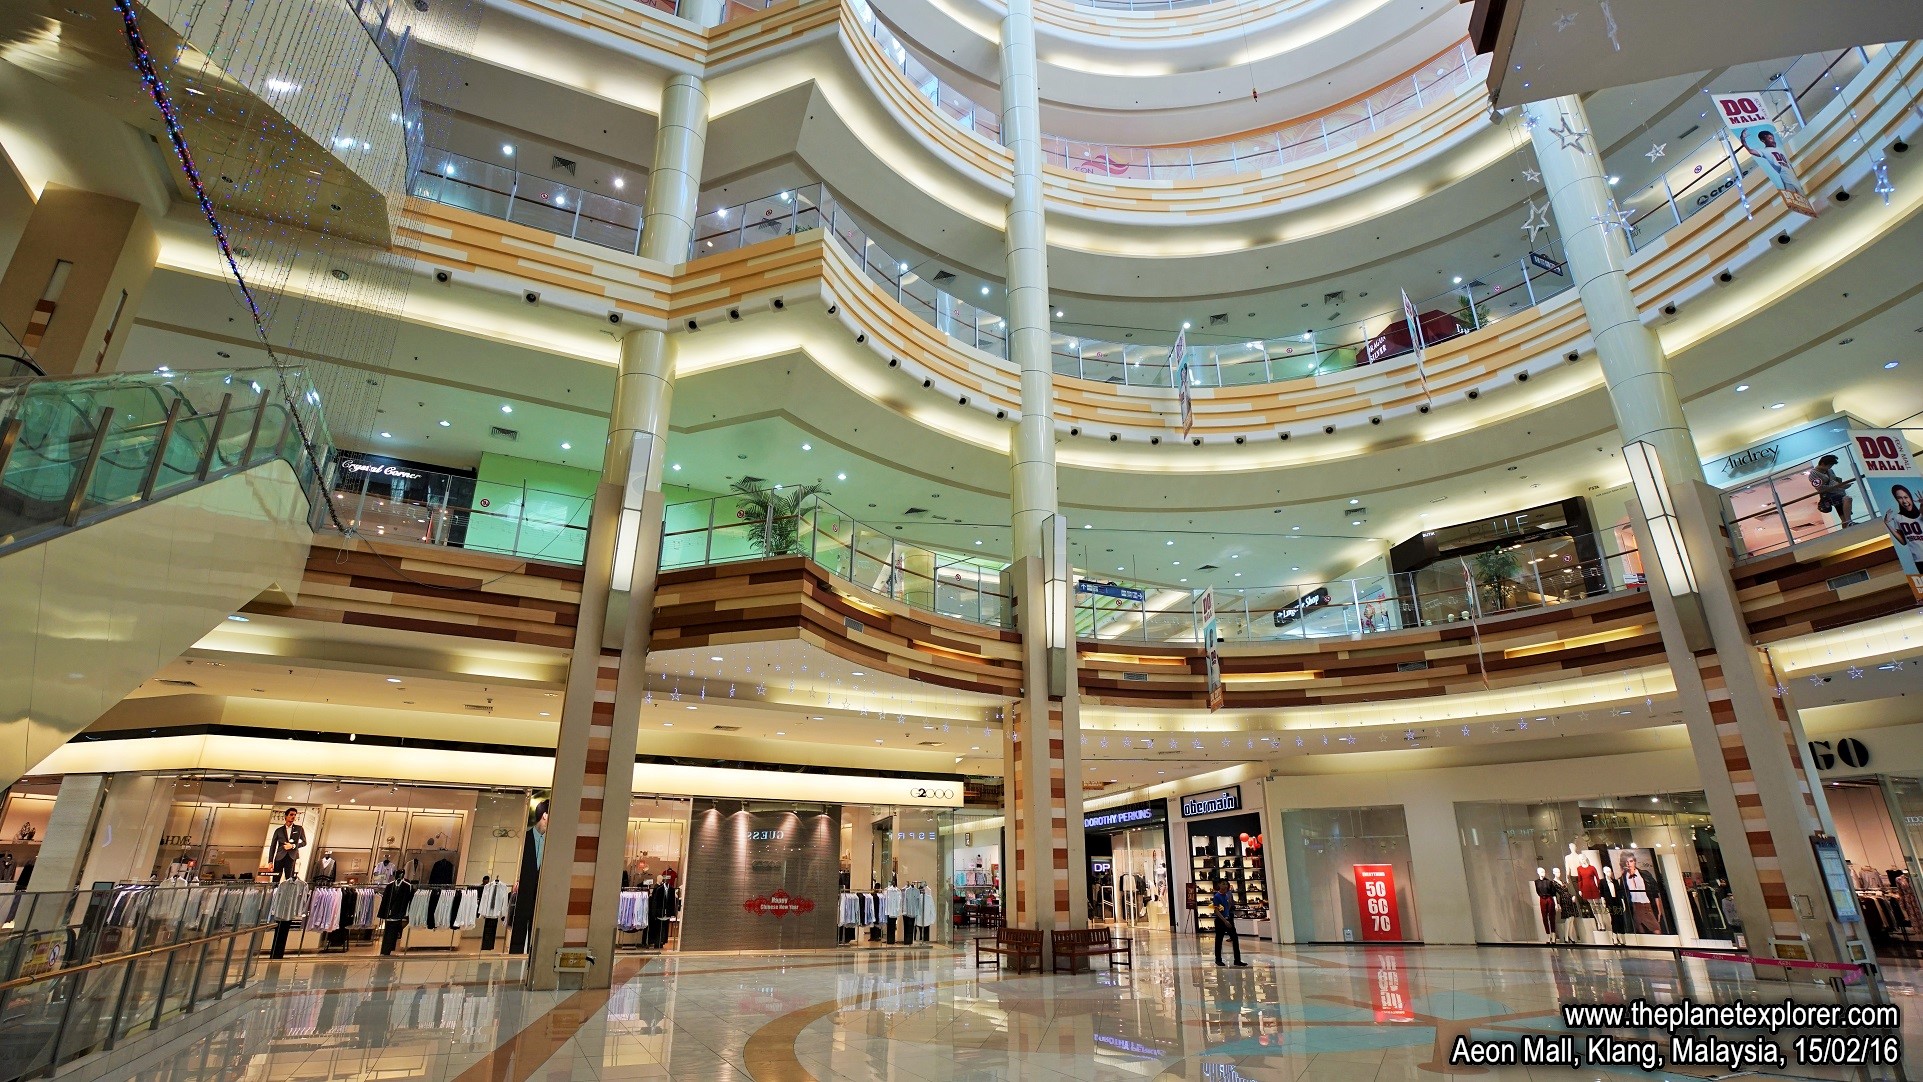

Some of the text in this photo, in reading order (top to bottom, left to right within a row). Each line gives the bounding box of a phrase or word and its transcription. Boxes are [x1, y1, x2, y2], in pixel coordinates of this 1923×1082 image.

[1720, 98, 1758, 116] DO
[1729, 114, 1765, 124] MALL
[1710, 171, 1749, 197] cros
[1855, 436, 1899, 459] DO
[1721, 445, 1779, 472] Audrey
[1865, 461, 1905, 470] MALL
[342, 460, 422, 479] Crystal Corner
[1305, 594, 1320, 608] Shop
[1808, 737, 1870, 770] GO
[910, 788, 954, 799] G2000
[1184, 793, 1236, 816] obermain
[1084, 808, 1152, 828] DOROTHY PERKINS
[1094, 863, 1111, 872] DP
[1365, 881, 1387, 897] 50
[1367, 898, 1389, 914] 60
[1371, 915, 1391, 932] 70
